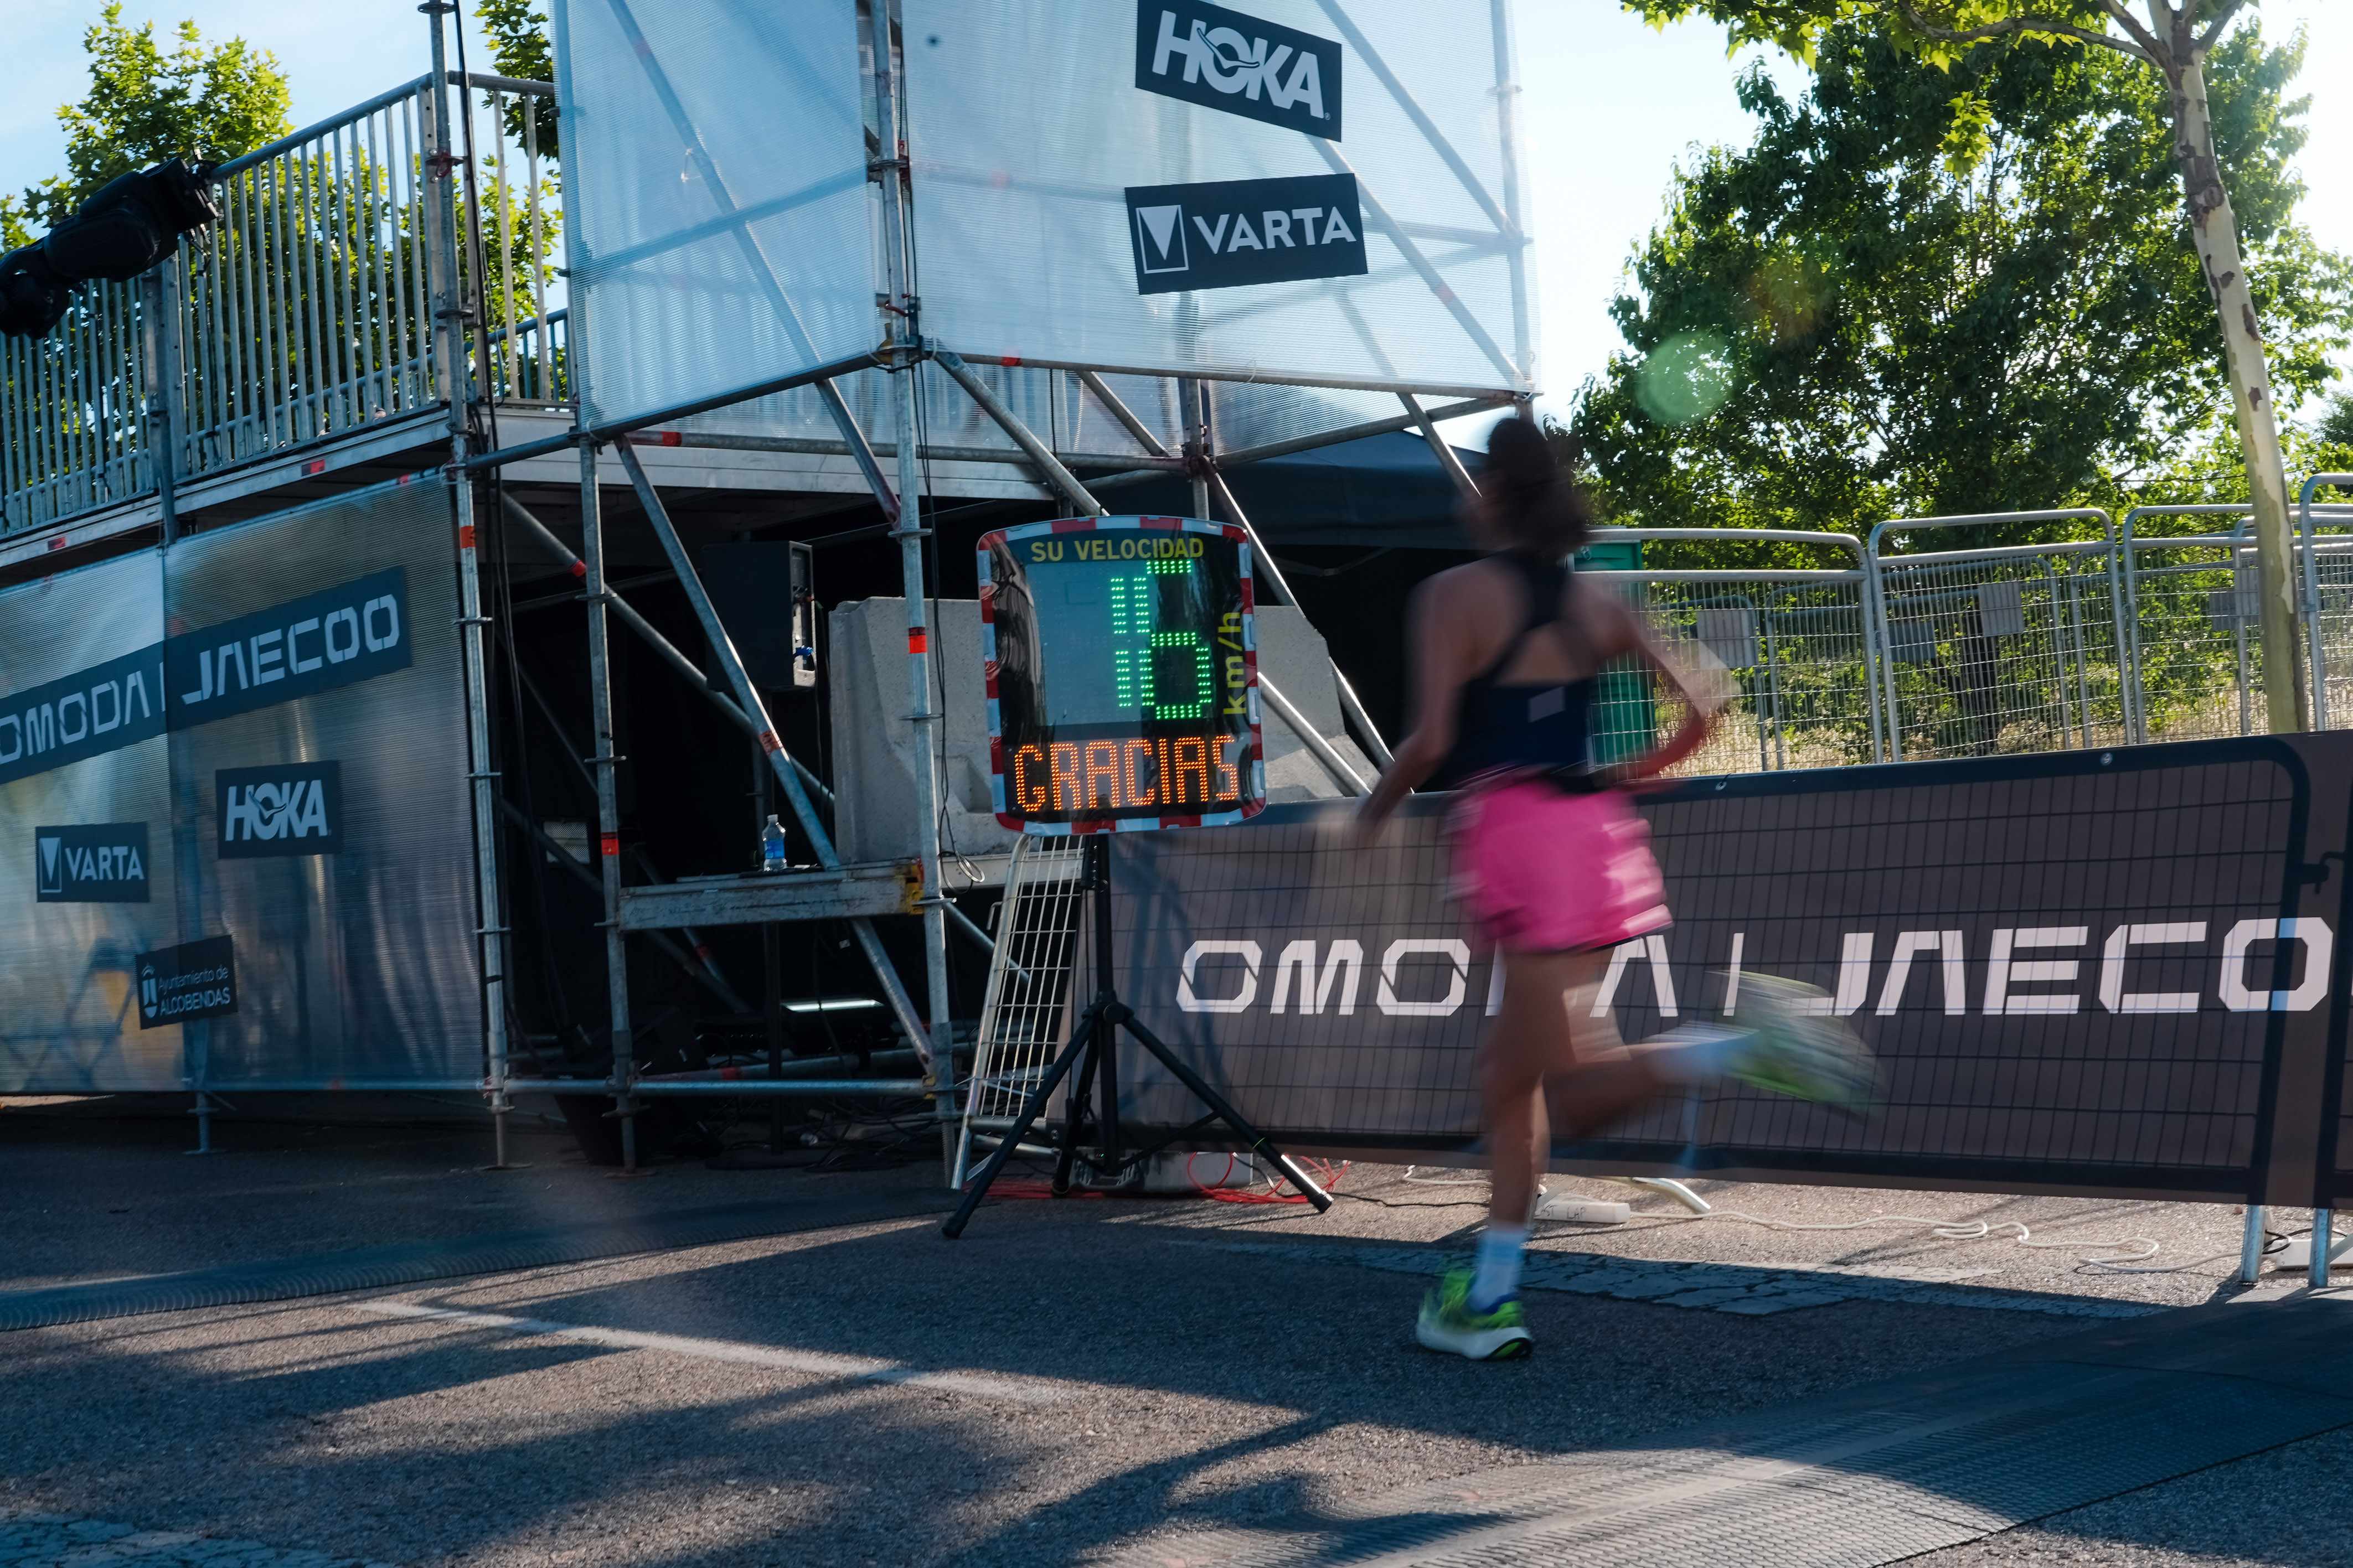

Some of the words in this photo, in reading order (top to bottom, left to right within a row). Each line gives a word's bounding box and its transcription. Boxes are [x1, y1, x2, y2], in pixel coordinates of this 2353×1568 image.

[1152, 10, 1324, 118] HOKA
[1192, 206, 1356, 254] VARTA
[1031, 541, 1063, 562] SU
[1075, 538, 1204, 561] VELOCIDAD
[182, 594, 400, 705] JAECOO
[1110, 560, 1212, 720] 16
[1218, 612, 1247, 715] km/h
[1014, 736, 1239, 812] GRACIAS
[225, 779, 328, 841] HOKA
[65, 846, 145, 881] VARTA
[158, 969, 214, 996] Ayuntamiento
[216, 964, 228, 979] de
[159, 986, 231, 1016] ALCOBENDAS
[1176, 934, 1678, 1017] OMOA
[1787, 917, 2353, 1016] JAECO
